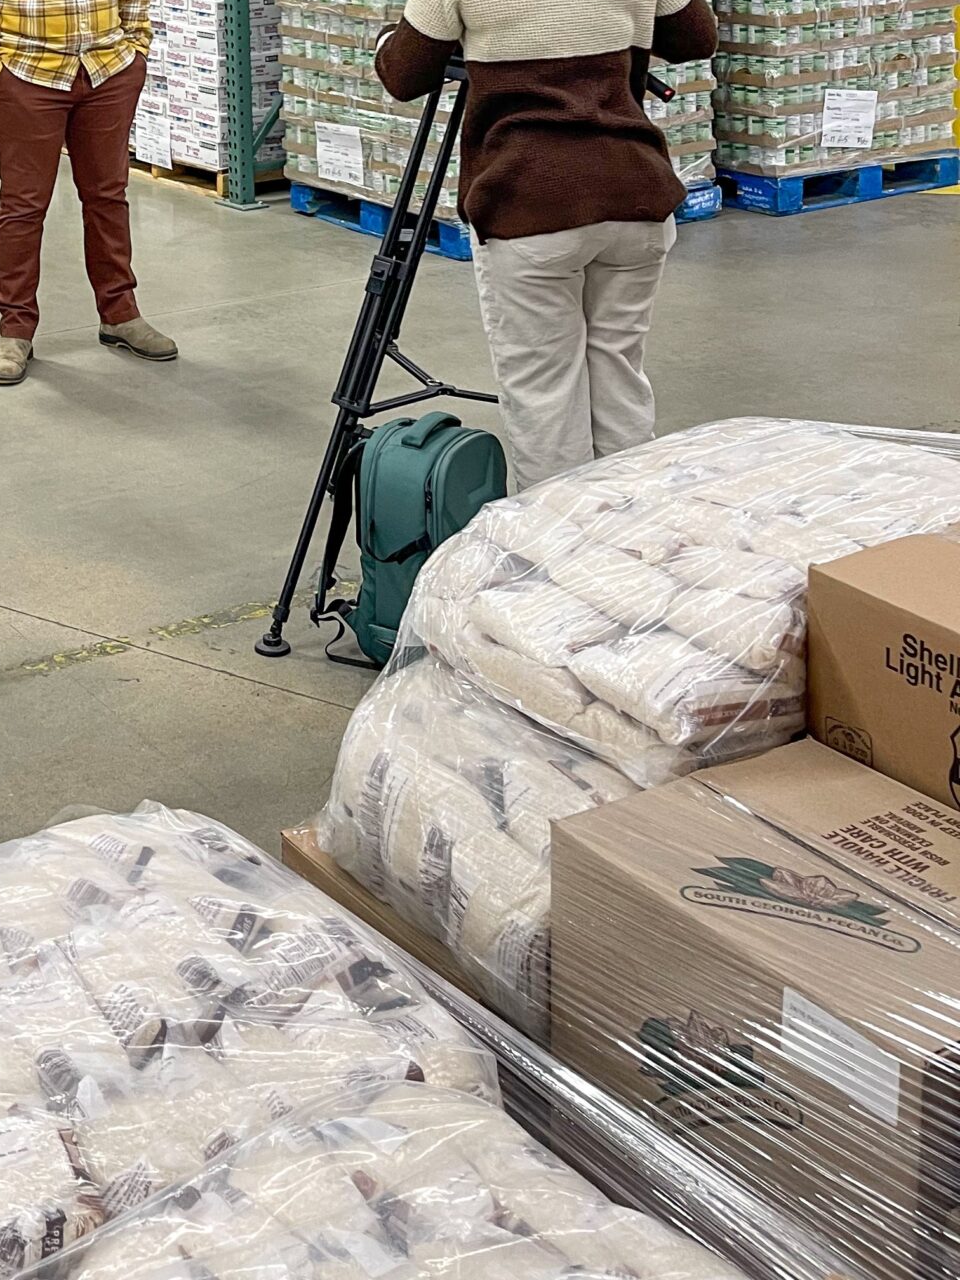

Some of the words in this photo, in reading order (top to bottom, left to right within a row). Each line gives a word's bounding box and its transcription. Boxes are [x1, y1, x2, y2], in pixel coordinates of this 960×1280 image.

[885, 647, 943, 694] Light
[871, 815, 890, 825] ON
[901, 805, 929, 821] COOL
[911, 801, 947, 819] PLACE
[883, 811, 927, 834] ARRIVAL
[926, 819, 943, 827] IN
[839, 824, 888, 849] CARE
[859, 818, 922, 852] PERISHABLE
[887, 824, 934, 847] EXAMINE
[820, 830, 890, 867] HANDLE
[883, 848, 931, 873] WITH
[919, 849, 951, 866] RUSH
[883, 864, 957, 903] FRAGILE
[693, 890, 747, 906] SOUTH
[750, 899, 824, 922] GEORGIA
[827, 916, 881, 938] PECAN
